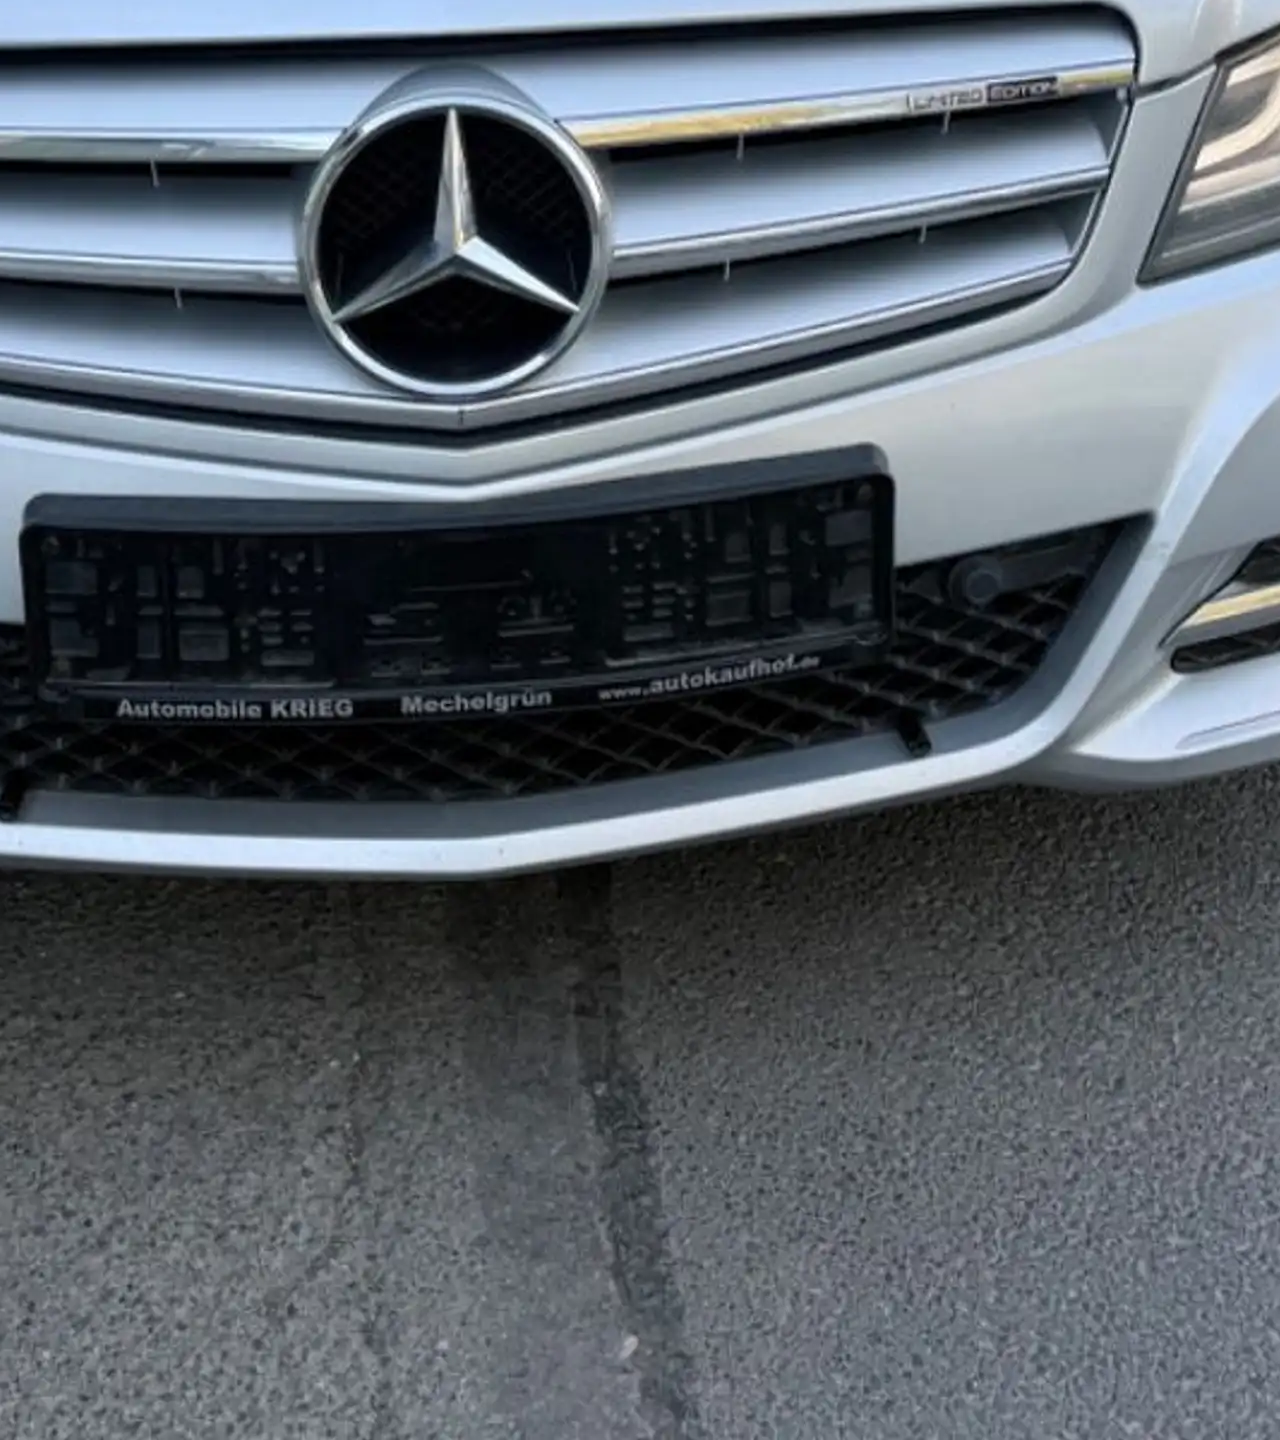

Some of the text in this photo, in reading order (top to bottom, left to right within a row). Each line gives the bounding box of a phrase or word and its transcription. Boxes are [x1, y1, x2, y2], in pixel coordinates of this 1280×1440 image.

[117, 698, 262, 719] Automobile
[270, 697, 354, 719] KRIEG
[401, 687, 552, 714] Mechelgrün
